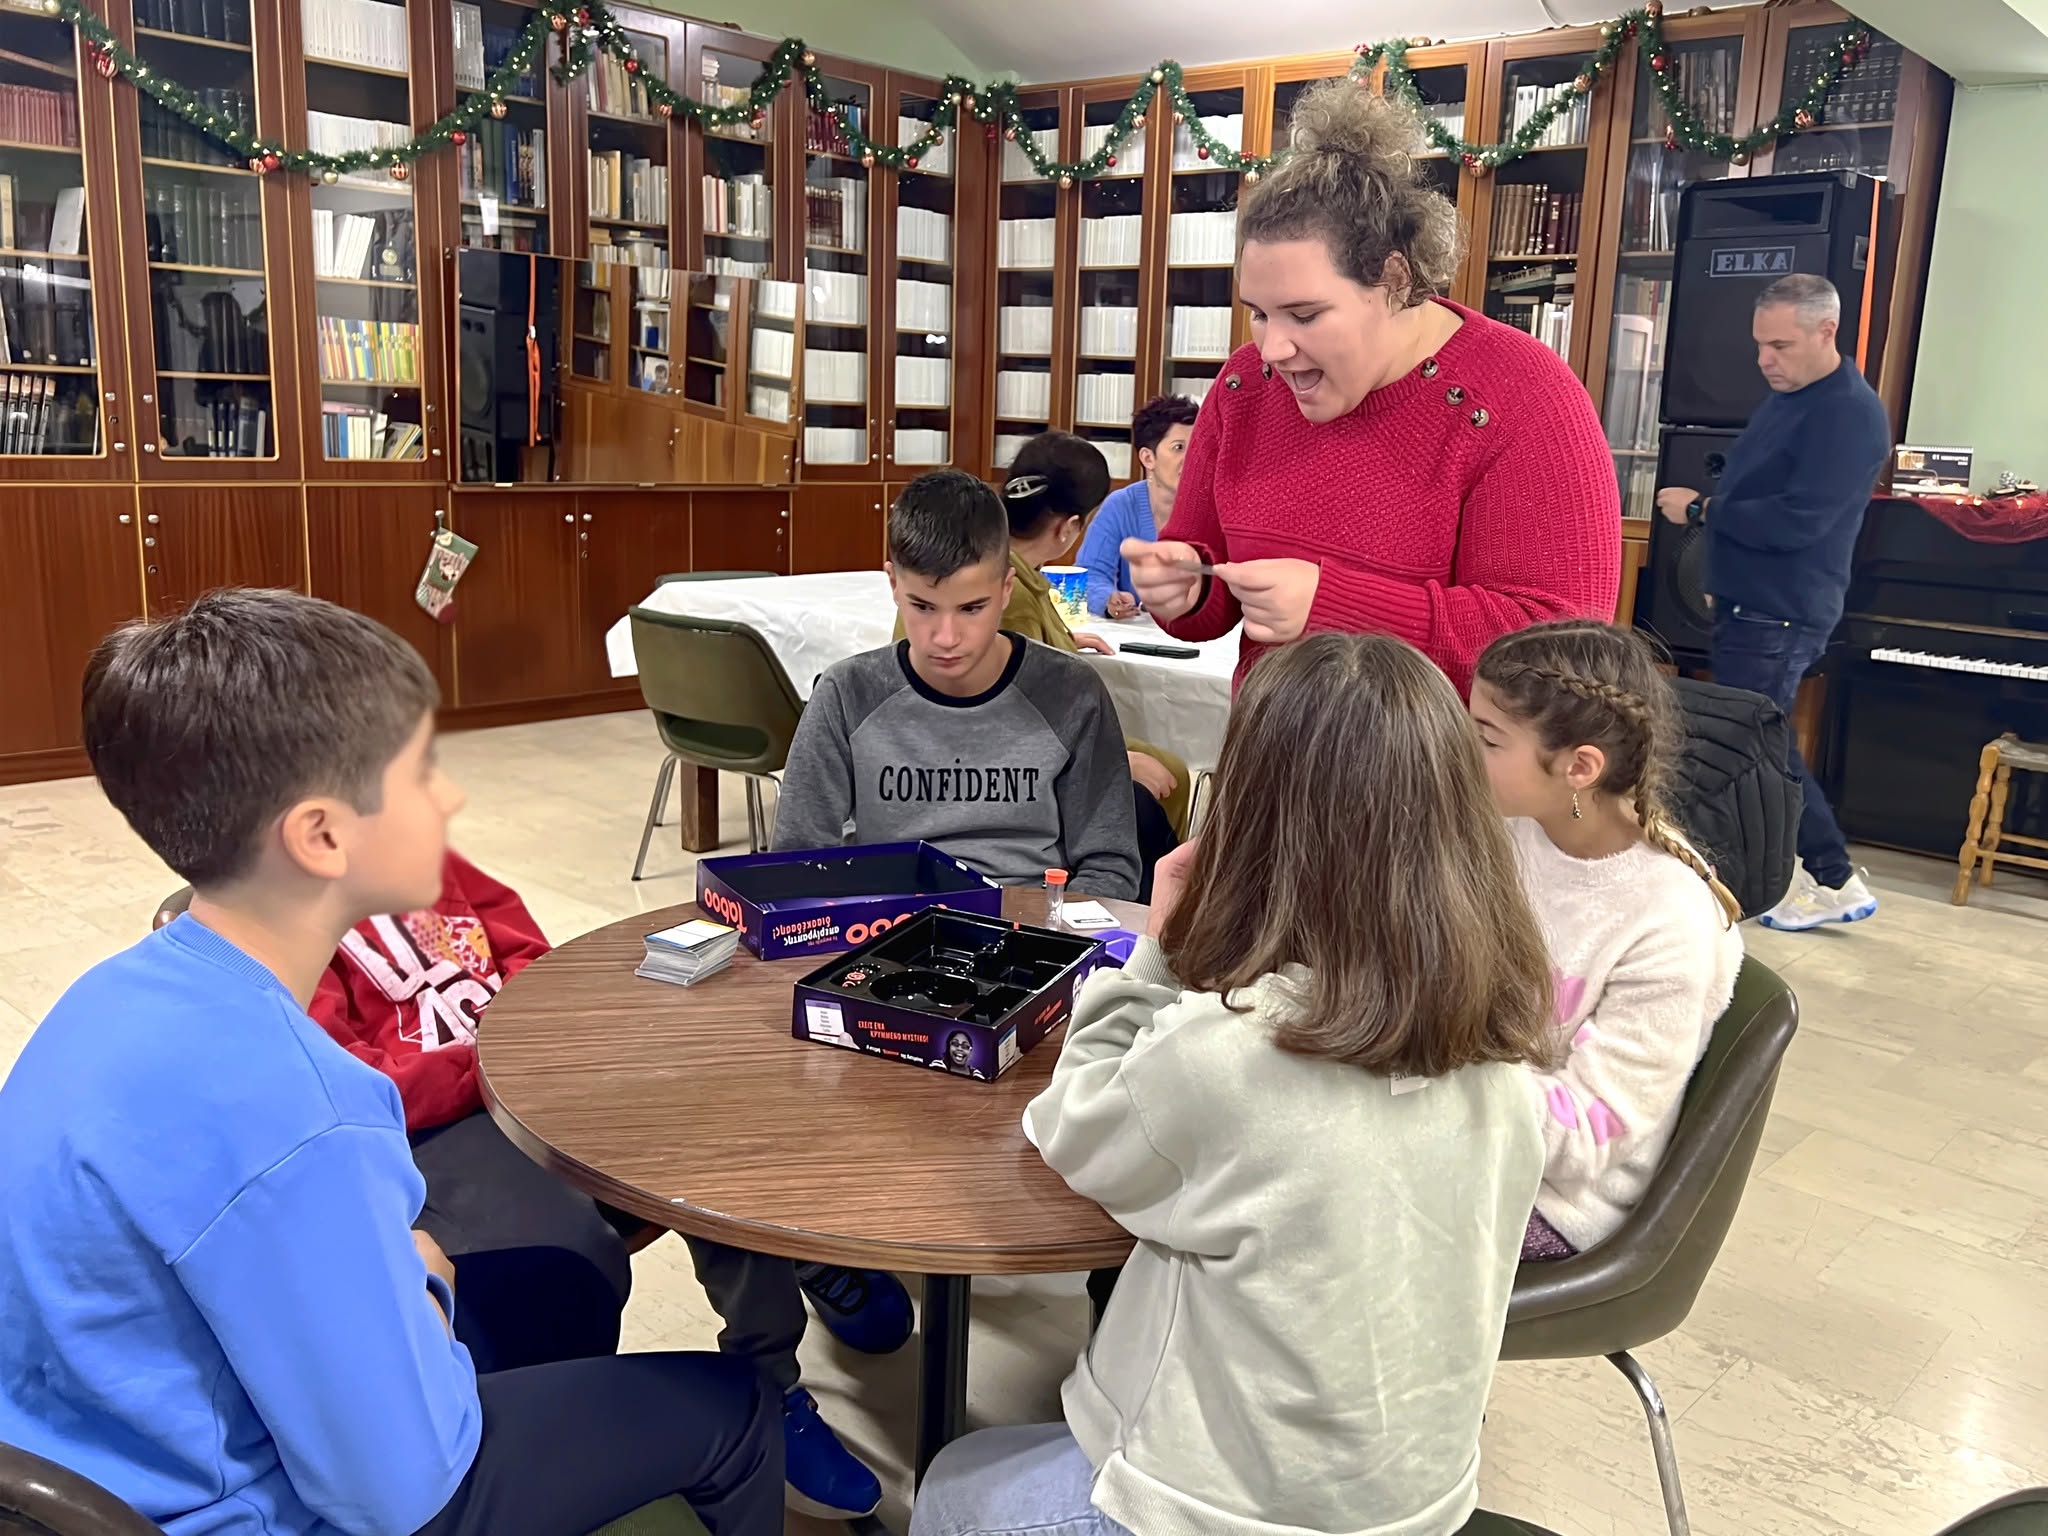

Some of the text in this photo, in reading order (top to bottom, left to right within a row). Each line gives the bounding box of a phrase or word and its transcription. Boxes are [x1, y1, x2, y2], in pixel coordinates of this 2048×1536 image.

[1715, 252, 1789, 272] ELKA
[704, 887, 748, 934] Taboo
[772, 915, 831, 941] διασκέδασης!
[783, 925, 840, 947] απερίγραπτης
